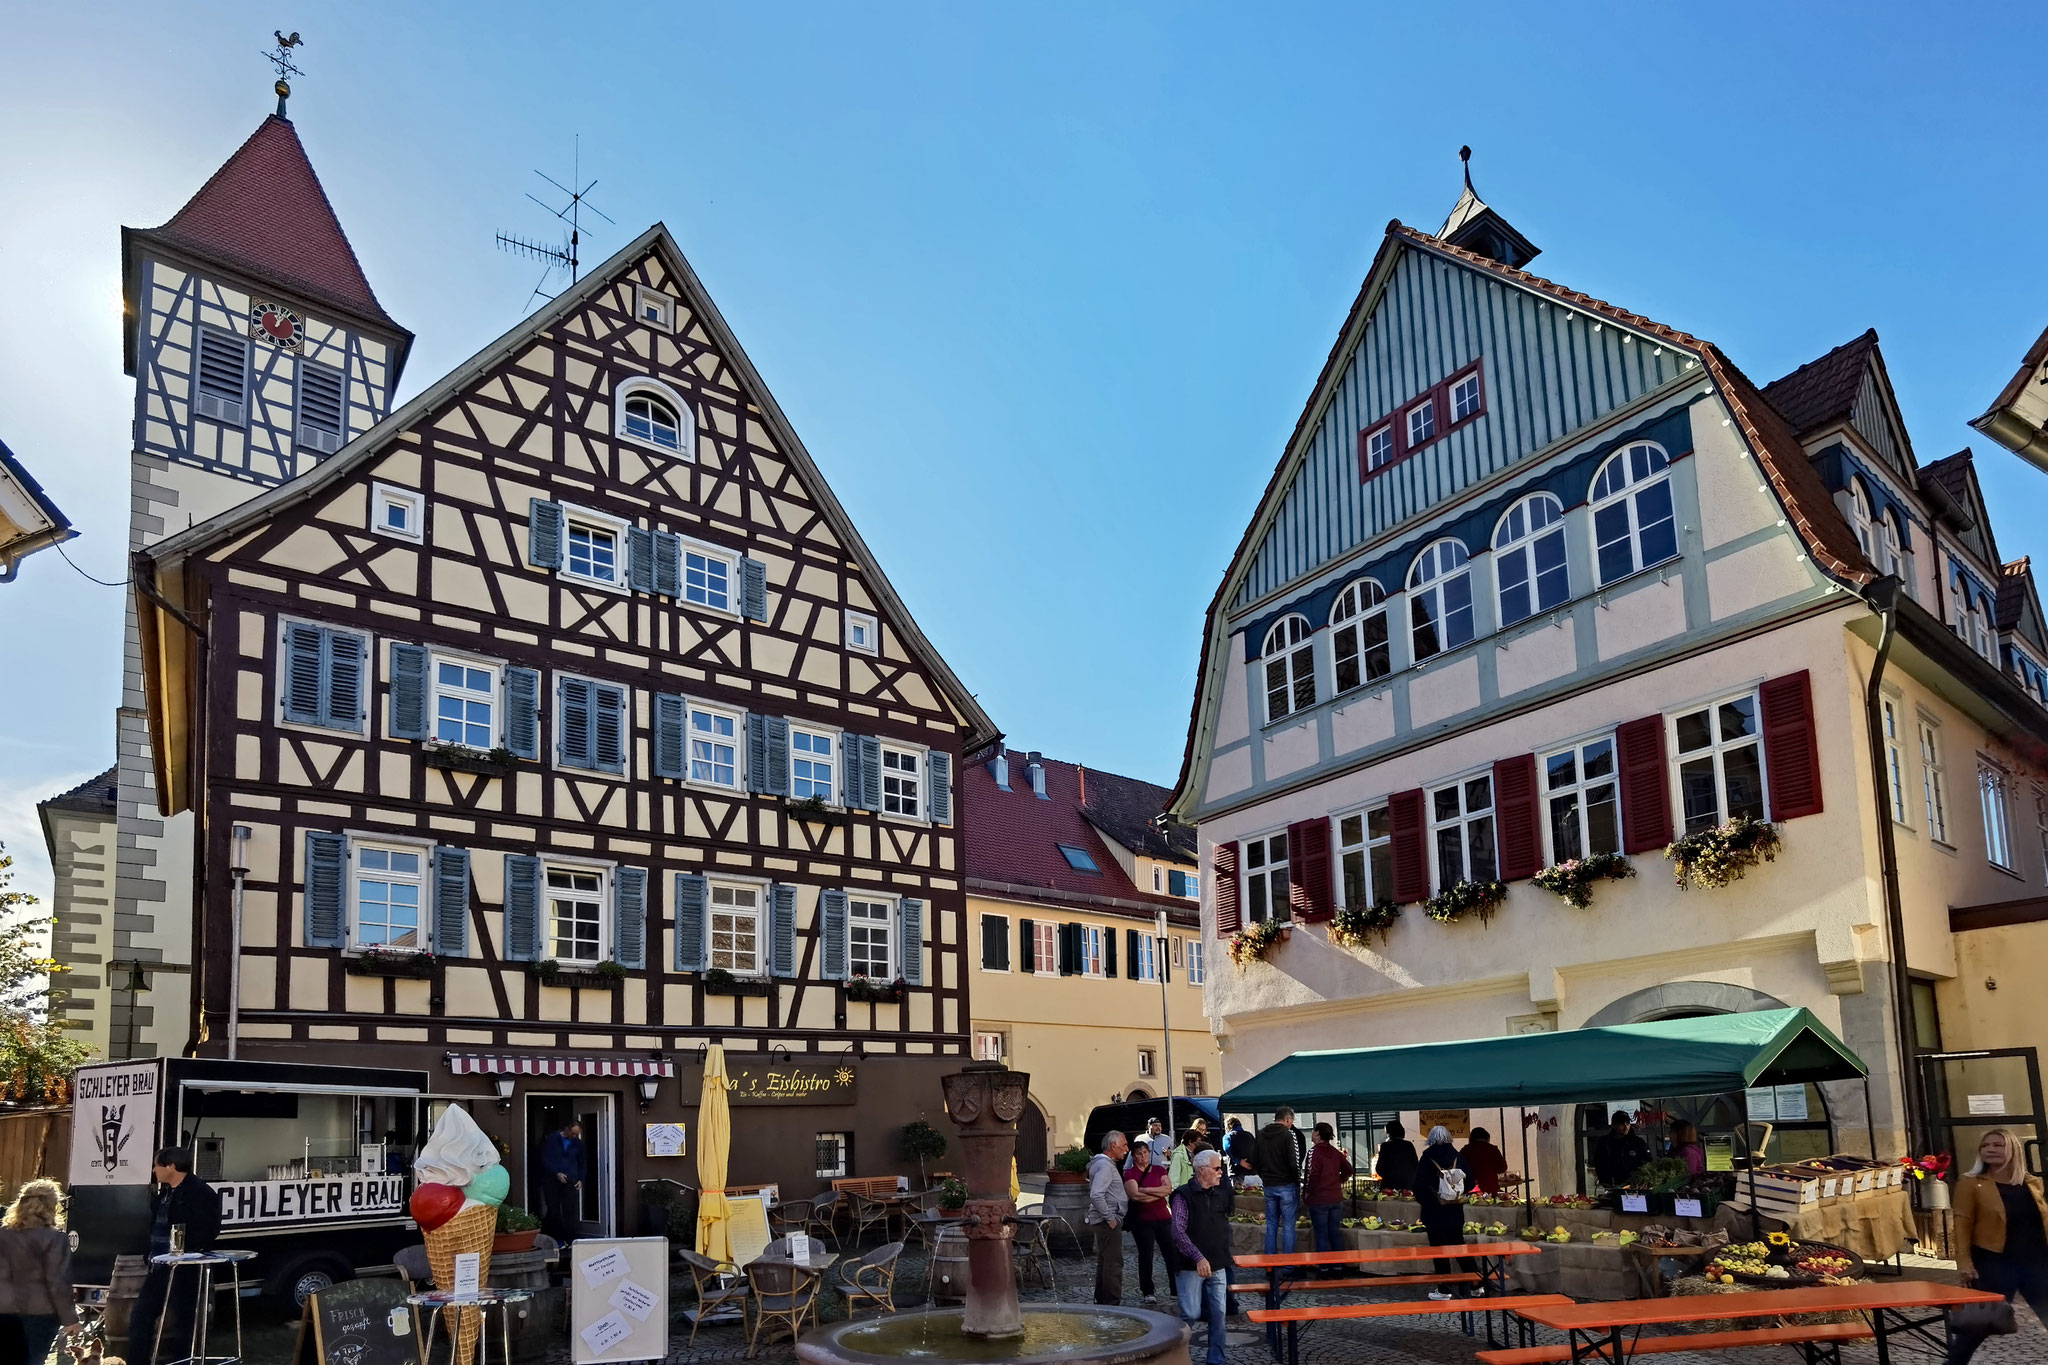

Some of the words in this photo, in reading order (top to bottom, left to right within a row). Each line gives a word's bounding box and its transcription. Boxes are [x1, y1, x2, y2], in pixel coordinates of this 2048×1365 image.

[80, 1074, 130, 1099] SCHLEYER
[132, 1069, 155, 1092] BRÄU
[766, 1068, 831, 1092] Eisbistro
[106, 1128, 116, 1157] S
[217, 1182, 343, 1220] CHLEYER
[351, 1177, 402, 1207] BRÄU
[330, 1307, 365, 1323] FRISCH
[342, 1317, 371, 1334] gezapft
